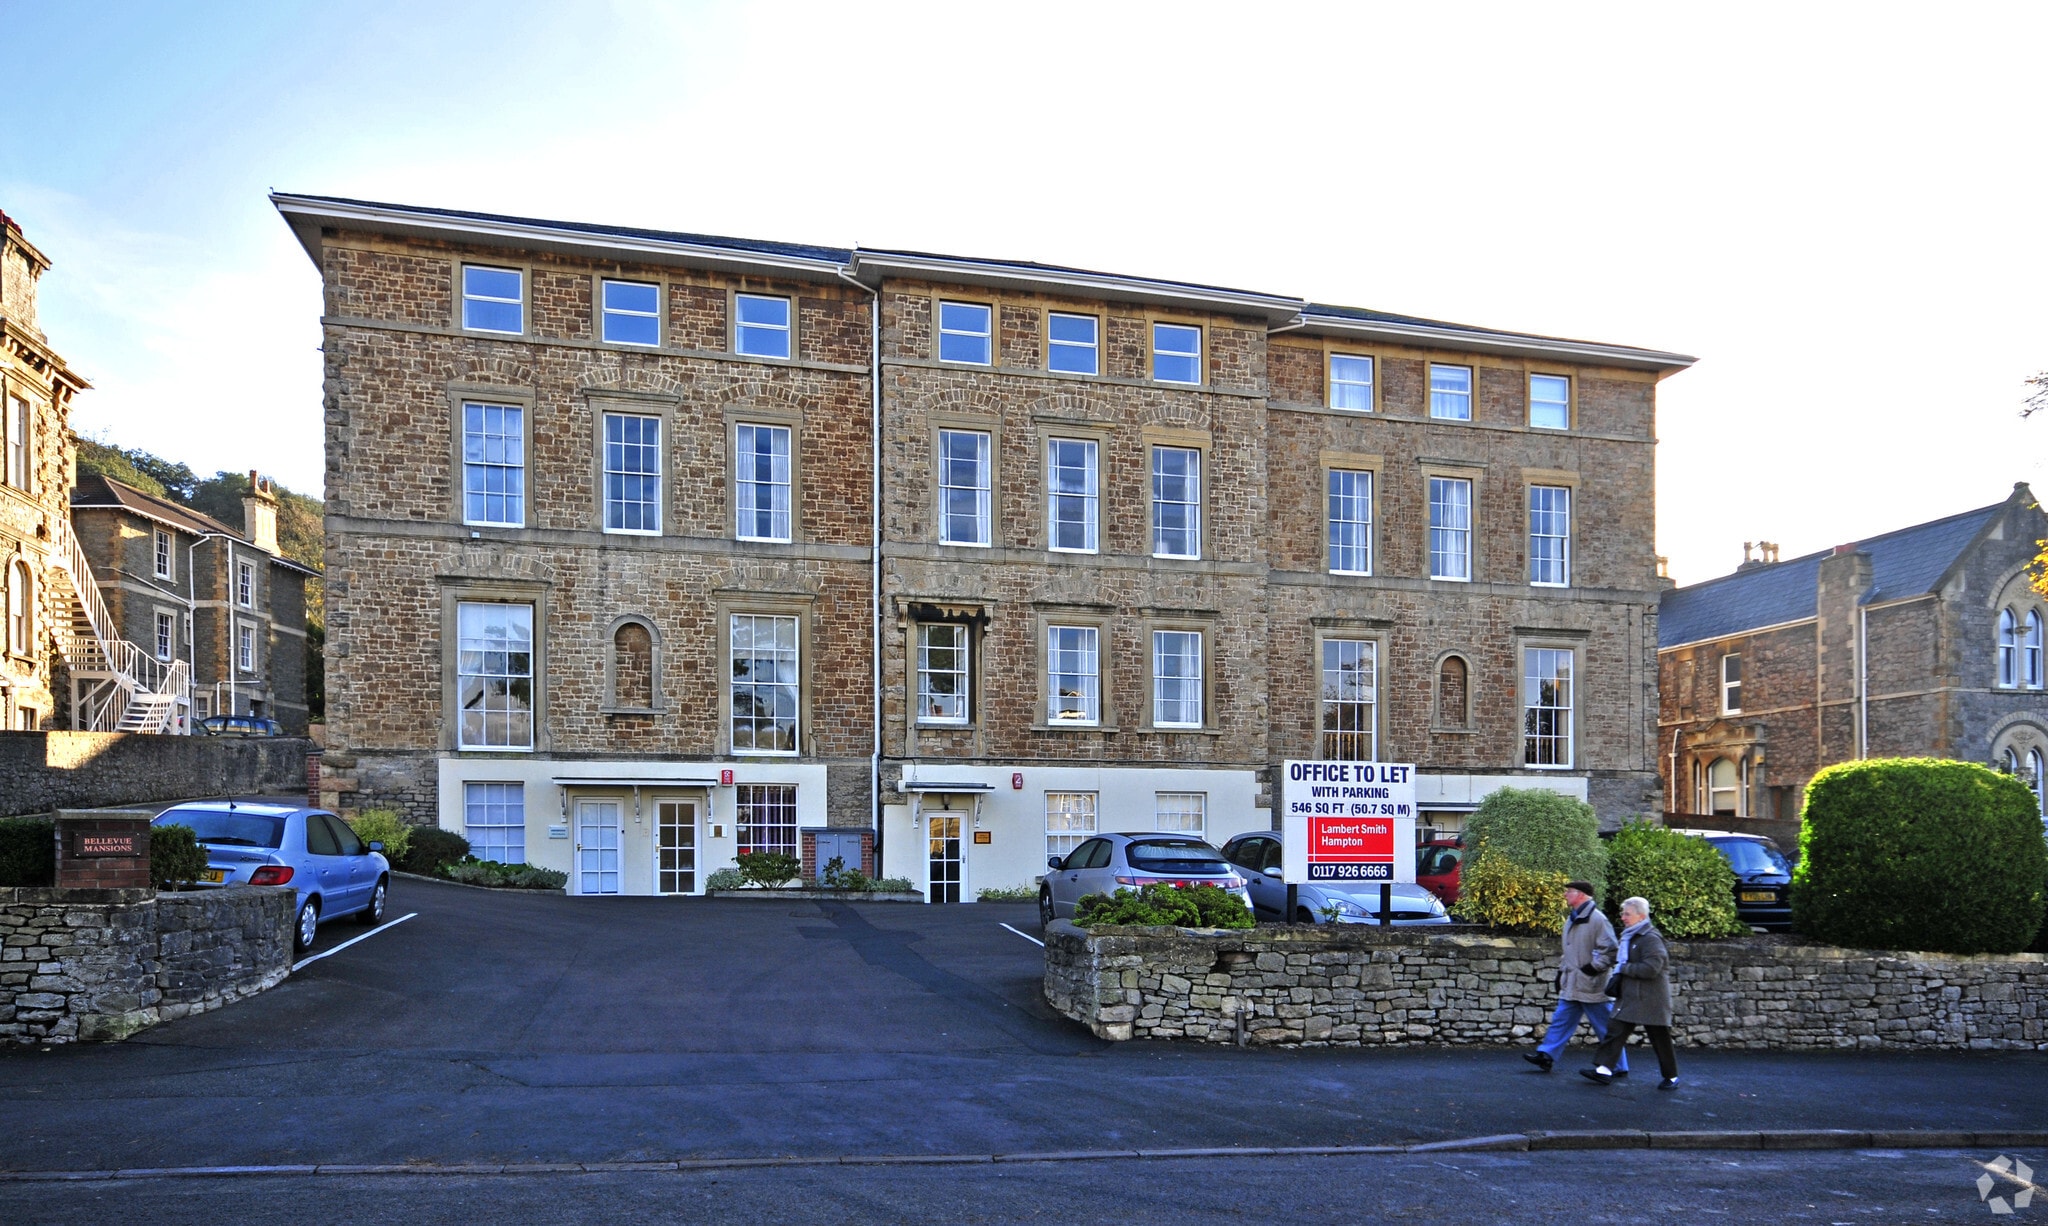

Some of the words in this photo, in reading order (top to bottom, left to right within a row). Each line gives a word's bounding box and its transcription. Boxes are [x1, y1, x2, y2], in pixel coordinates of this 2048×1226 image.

[1290, 763, 1349, 782] OFFICE
[1354, 765, 1375, 783] TO
[1381, 766, 1409, 783] LET
[1312, 786, 1339, 798] WITH
[1342, 787, 1389, 799] PARKING
[1291, 802, 1312, 813] 546
[1315, 803, 1329, 815] SQ
[1333, 803, 1345, 814] FT
[1351, 803, 1378, 817] (50.7
[1381, 804, 1394, 816] SQ
[1397, 804, 1411, 817] M)
[1321, 823, 1359, 834] Lambert
[1361, 824, 1387, 834] Smith
[1321, 836, 1363, 848] Hampton
[1312, 865, 1336, 877] 0117
[1338, 865, 1359, 877] 926
[1360, 865, 1388, 877] 6666
